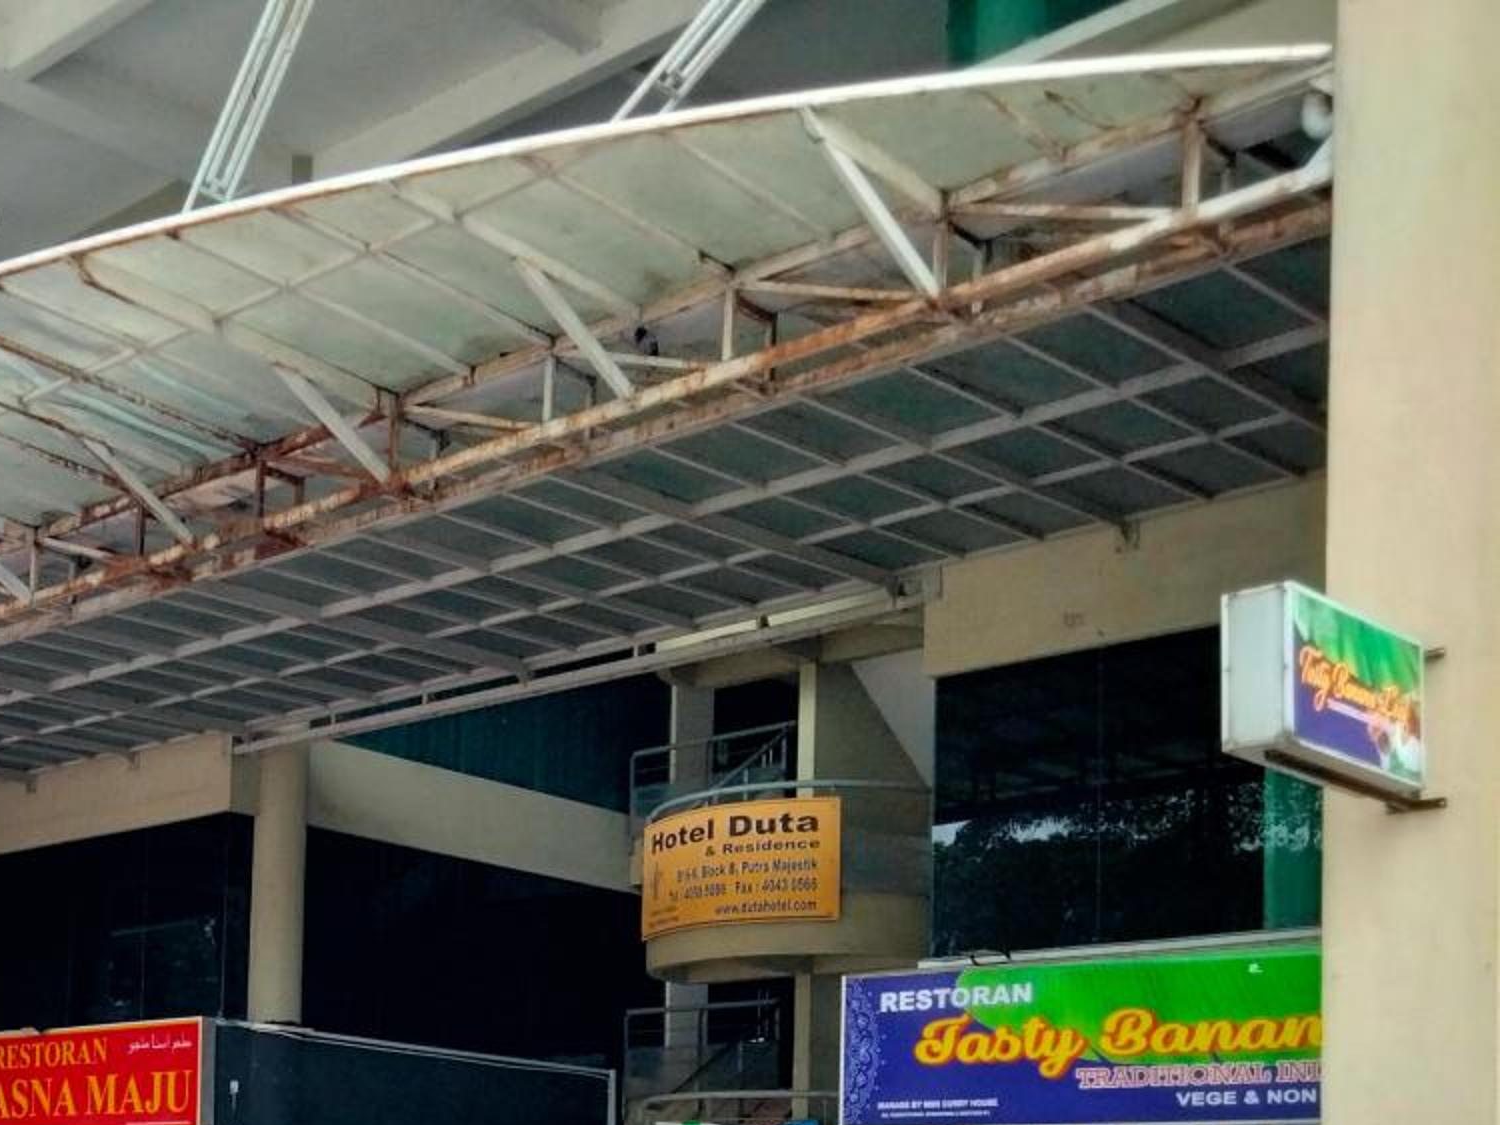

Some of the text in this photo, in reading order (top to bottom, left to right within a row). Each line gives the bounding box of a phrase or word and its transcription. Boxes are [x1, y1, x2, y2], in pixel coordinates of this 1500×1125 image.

[651, 812, 820, 856] Hotel Duta
[704, 839, 821, 857] & Residence
[879, 983, 1033, 1014] RESTORAN
[913, 1013, 1088, 1079] Tasty
[1075, 1059, 1321, 1089] TRADITIONAL IN
[85, 1070, 193, 1117] MAJU
[1175, 1092, 1238, 1107] VEGE
[1243, 1089, 1260, 1105] &
